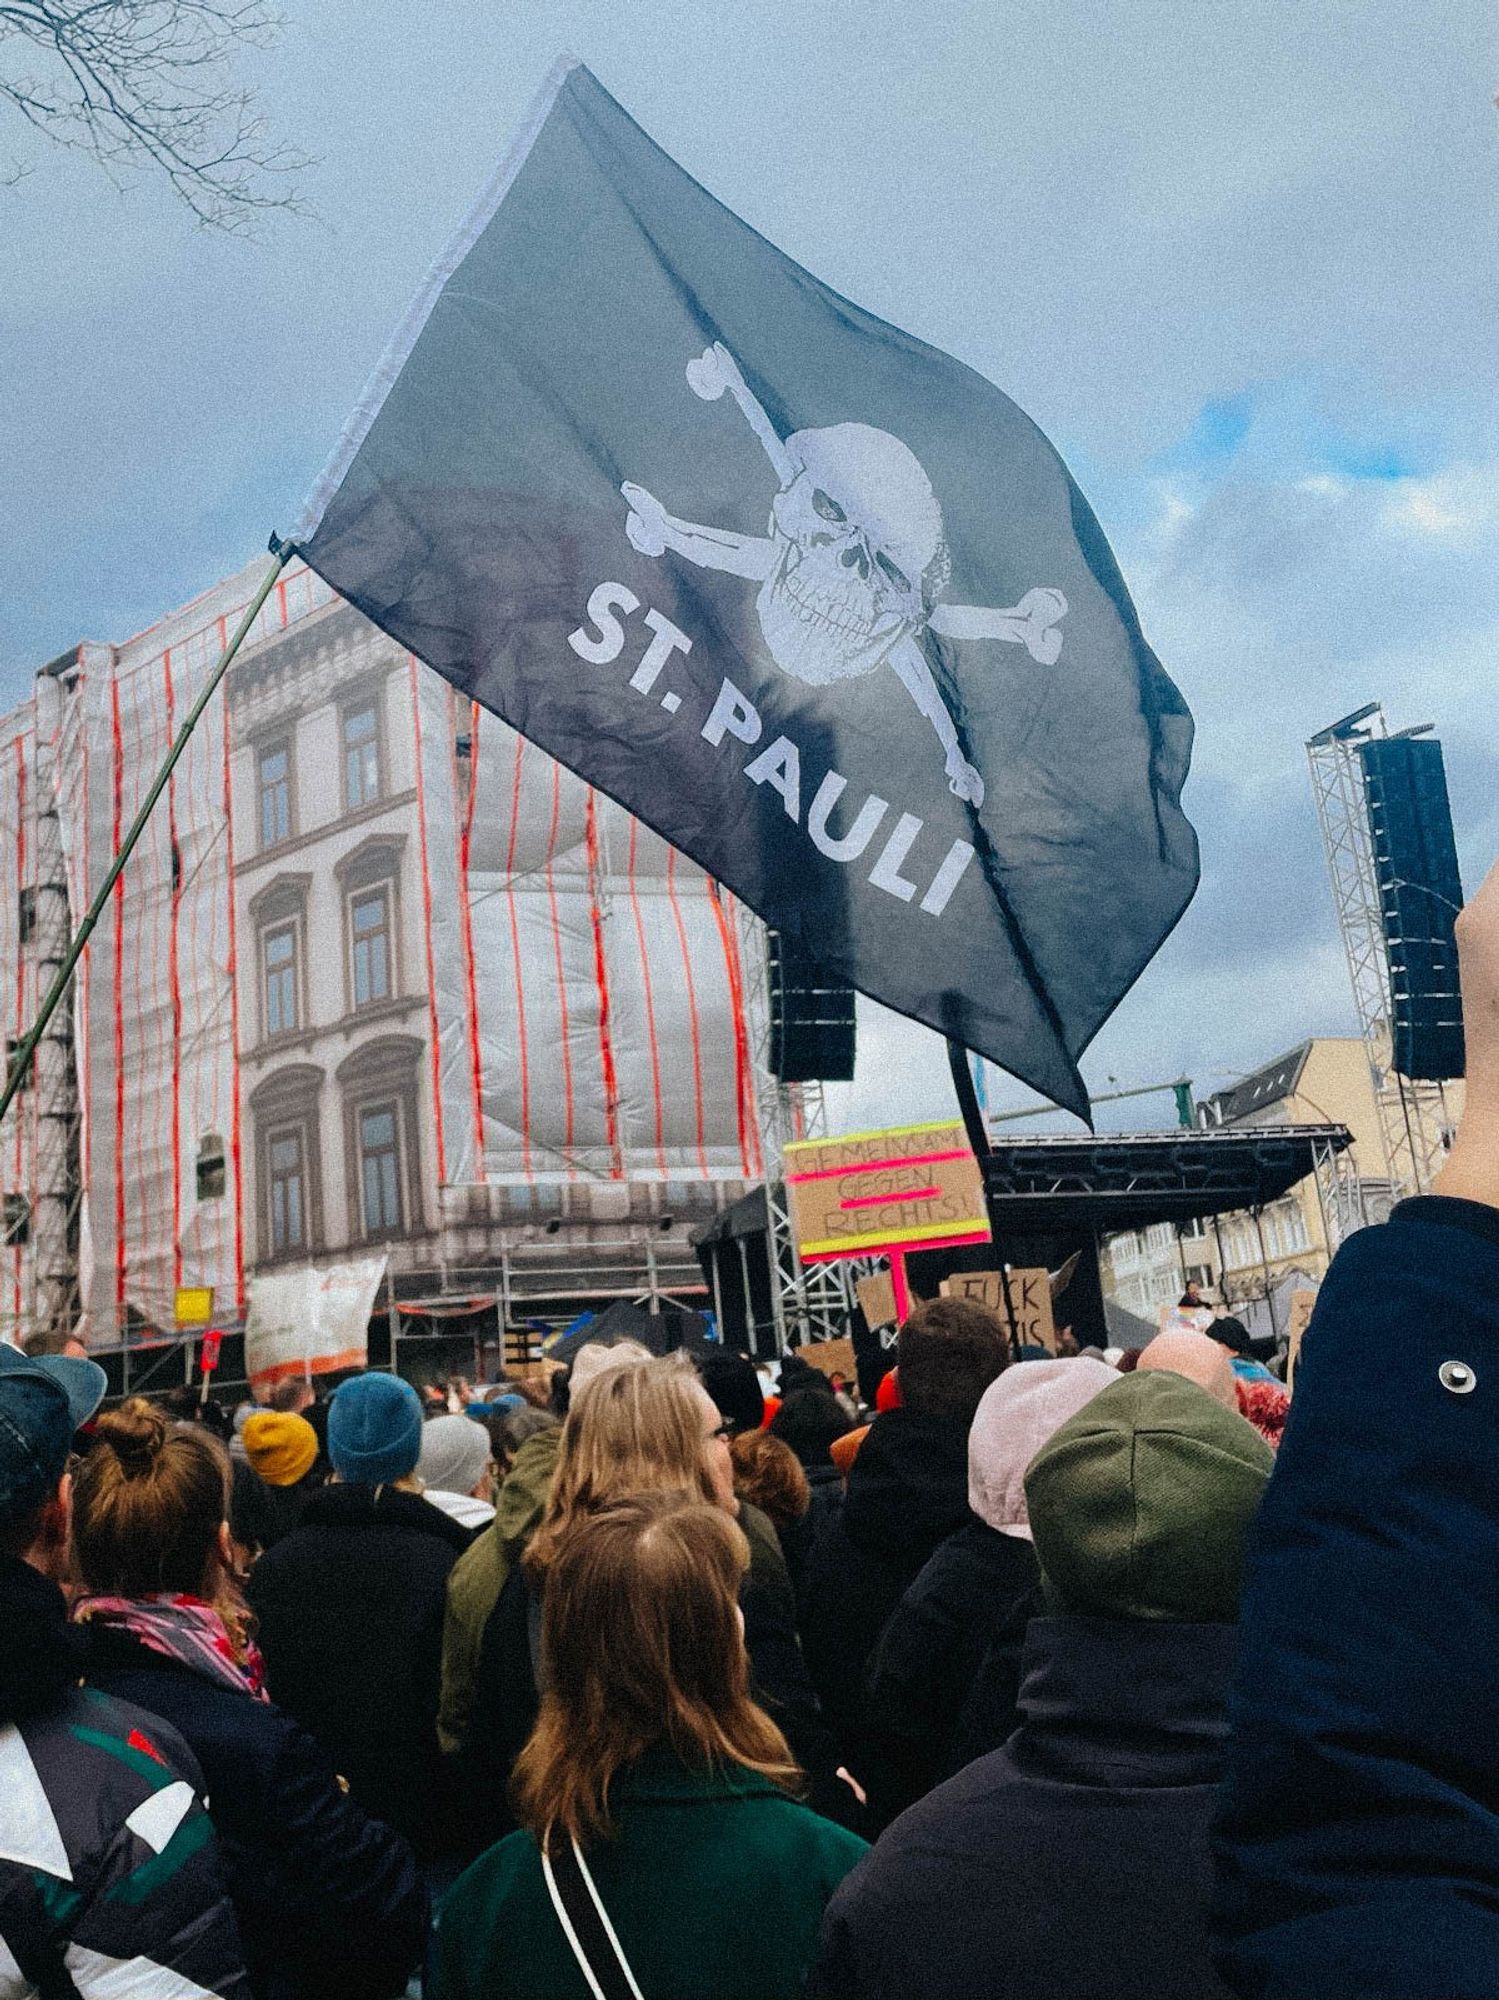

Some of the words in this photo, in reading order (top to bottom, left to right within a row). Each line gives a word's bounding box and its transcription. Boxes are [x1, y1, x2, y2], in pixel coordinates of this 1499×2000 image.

[567, 581, 693, 714] ST.
[700, 677, 975, 917] PAULI
[824, 1192, 974, 1238] RECHTS!
